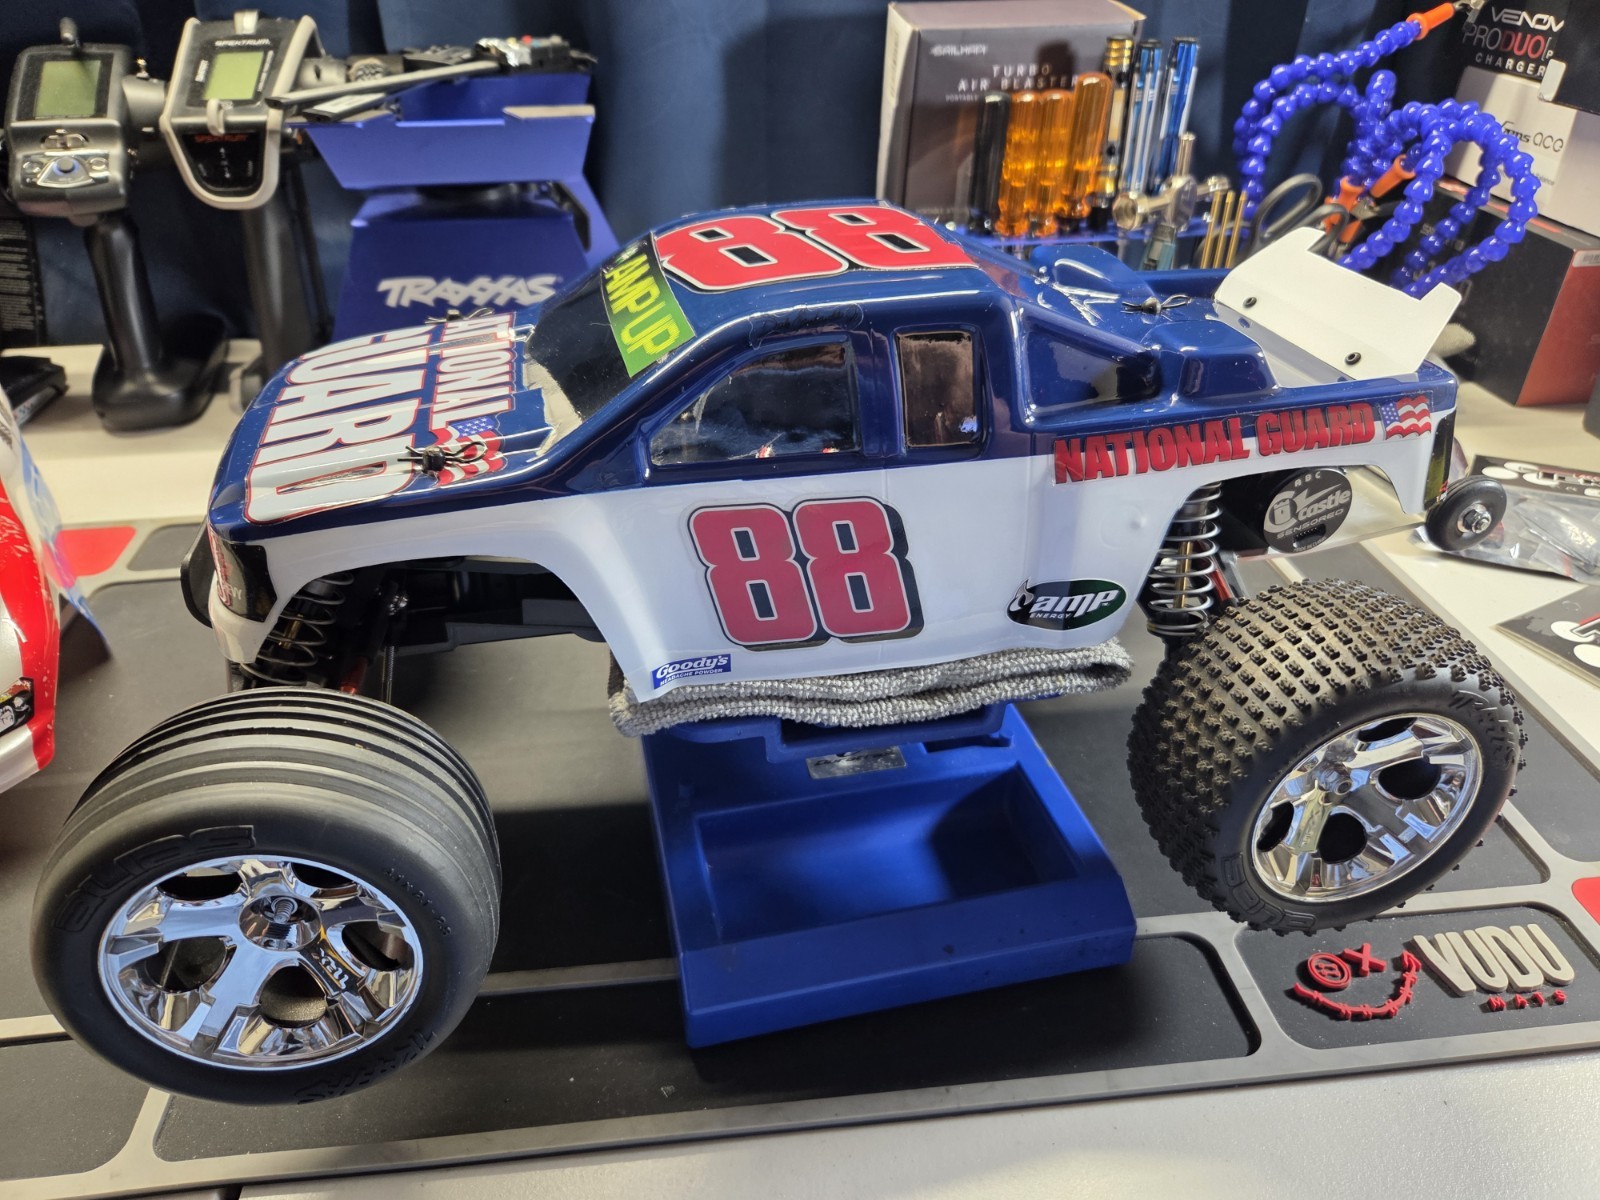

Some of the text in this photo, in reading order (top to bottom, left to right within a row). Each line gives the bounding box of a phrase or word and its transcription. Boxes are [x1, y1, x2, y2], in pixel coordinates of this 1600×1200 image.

[991, 64, 1051, 79] TURBO
[1475, 52, 1547, 77] CHARGER
[957, 74, 1079, 92] AIR BLASTER
[1532, 131, 1564, 153] ace
[653, 205, 980, 293] 88
[377, 274, 557, 308] TRAXXAS
[604, 253, 681, 355] AMP UP
[1053, 402, 1377, 484] NATIONAL GUARD
[1298, 489, 1352, 521] castle
[1276, 508, 1345, 540] SENSORED
[687, 496, 924, 653] 88
[1029, 612, 1073, 620] ENERGY
[656, 655, 729, 680] Goody's
[660, 668, 724, 687] HEADACHE POWDER
[1412, 923, 1576, 997] VUDU
[1487, 988, 1568, 1013] MATS
